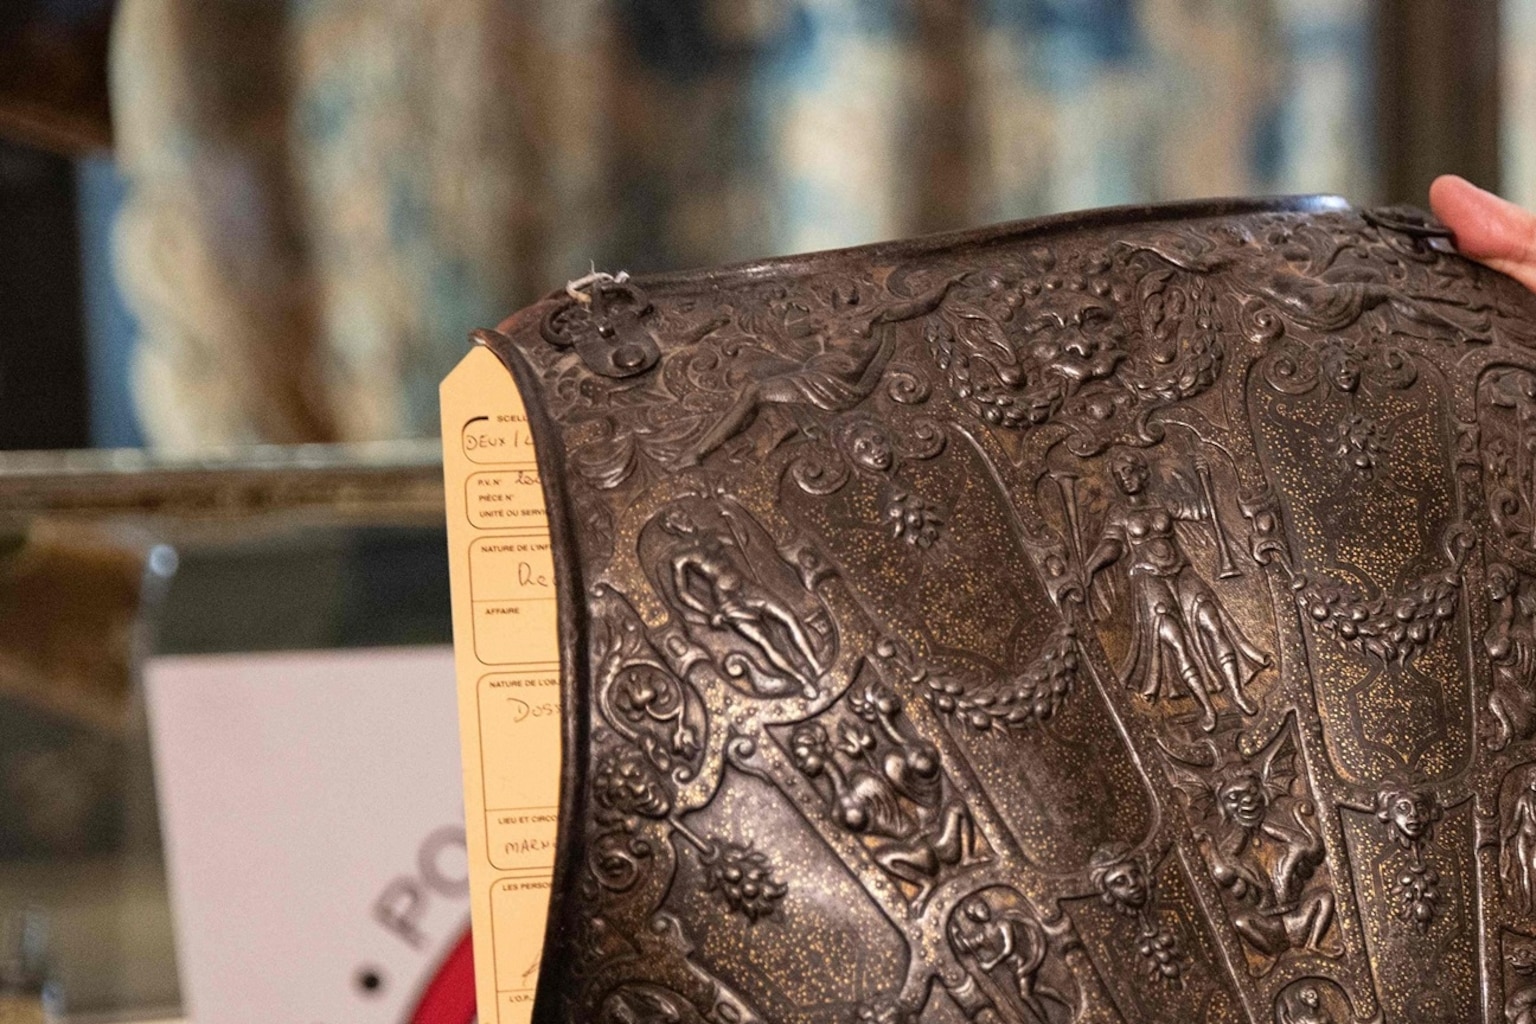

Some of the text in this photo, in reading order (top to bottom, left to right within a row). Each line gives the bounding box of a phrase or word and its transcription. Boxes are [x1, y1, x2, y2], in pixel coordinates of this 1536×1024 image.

[465, 434, 506, 451] DEUX
[506, 509, 519, 518] OU
[481, 544, 514, 553] NATURE
[517, 544, 528, 552] DE
[485, 607, 520, 616] AFFAIRE
[489, 680, 523, 688] NATURE
[525, 679, 536, 687] DE
[498, 816, 517, 825] LIEU
[519, 815, 529, 824] ET
[502, 883, 519, 892] LES
